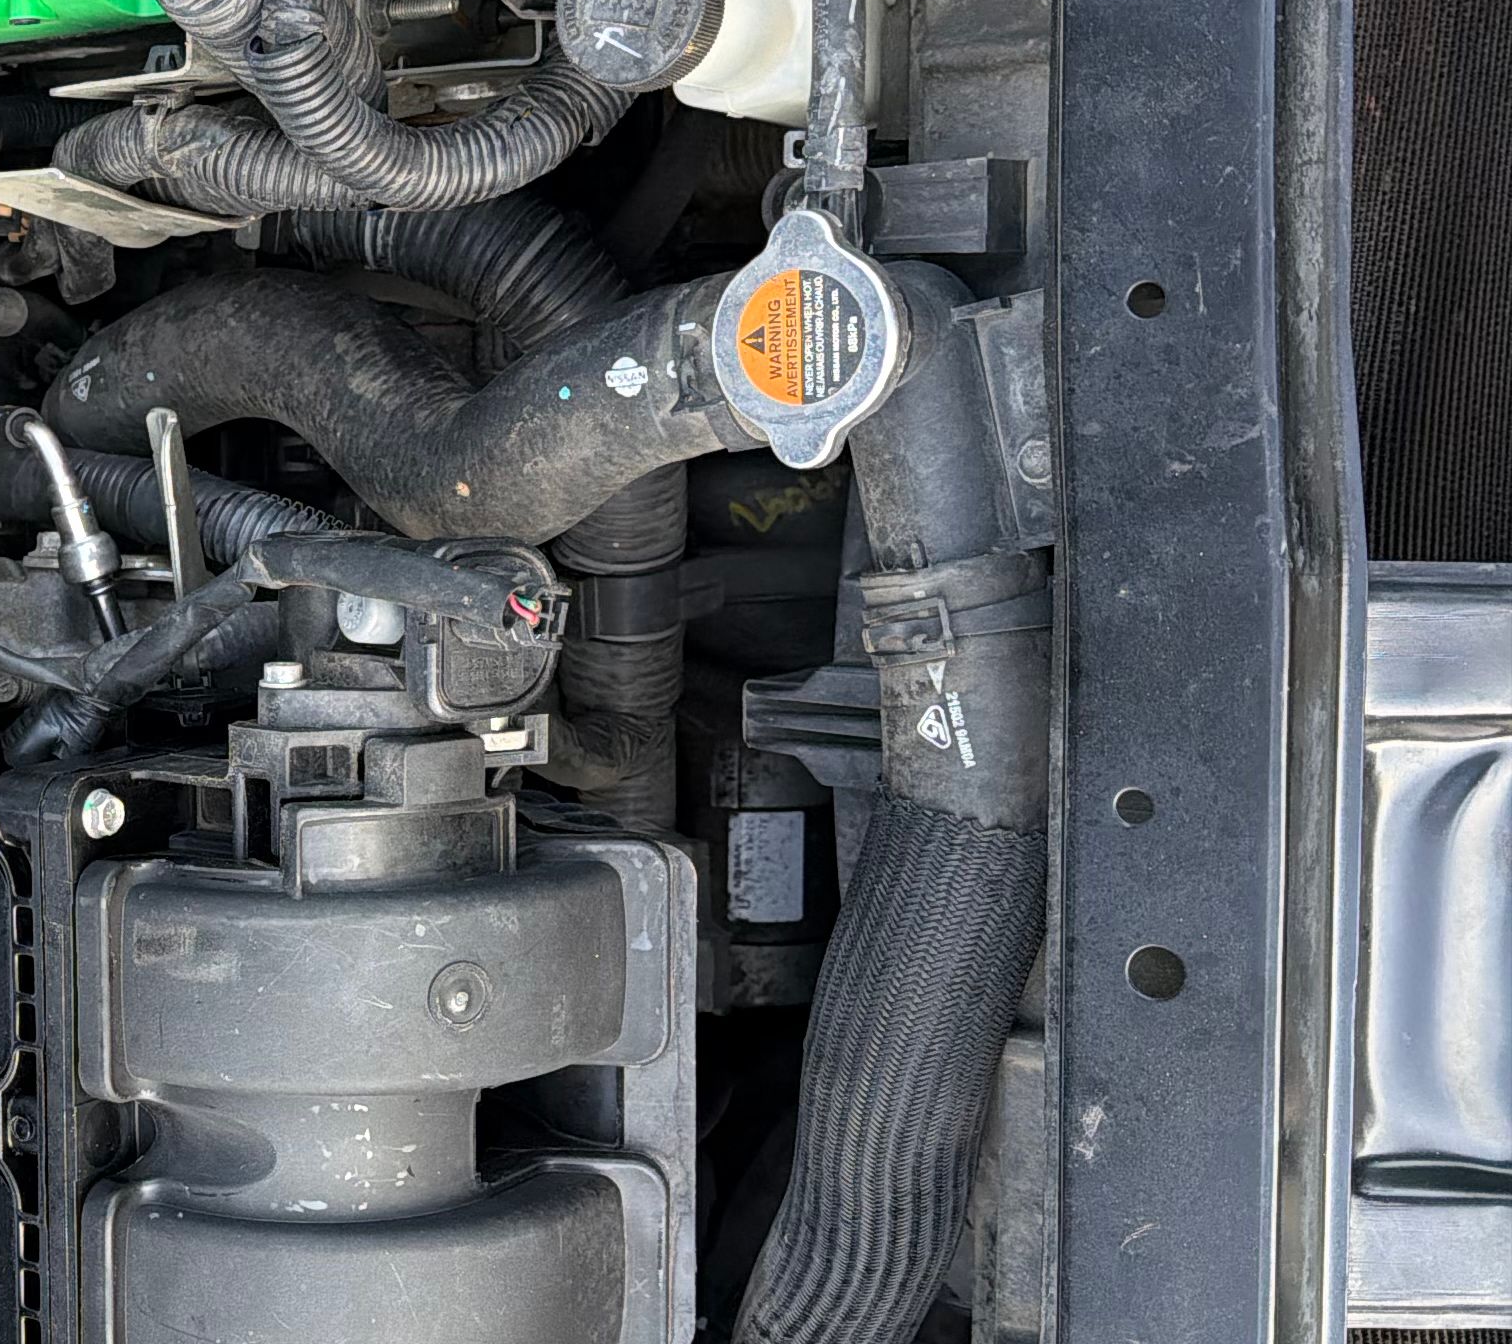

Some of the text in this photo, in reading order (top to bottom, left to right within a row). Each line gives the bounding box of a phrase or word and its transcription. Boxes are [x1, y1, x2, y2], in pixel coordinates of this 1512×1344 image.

[814, 275, 824, 309] CHAUD.
[831, 288, 840, 305] LTD.
[768, 299, 782, 380] WARNING
[784, 278, 798, 398] AVERTISSEMENT
[803, 278, 814, 395] NEVER OPEN WHEN HOT.
[815, 318, 825, 352] OUVRIR
[832, 322, 840, 352] MOTOR
[832, 353, 841, 382] NISSAN
[945, 691, 965, 728] 21502
